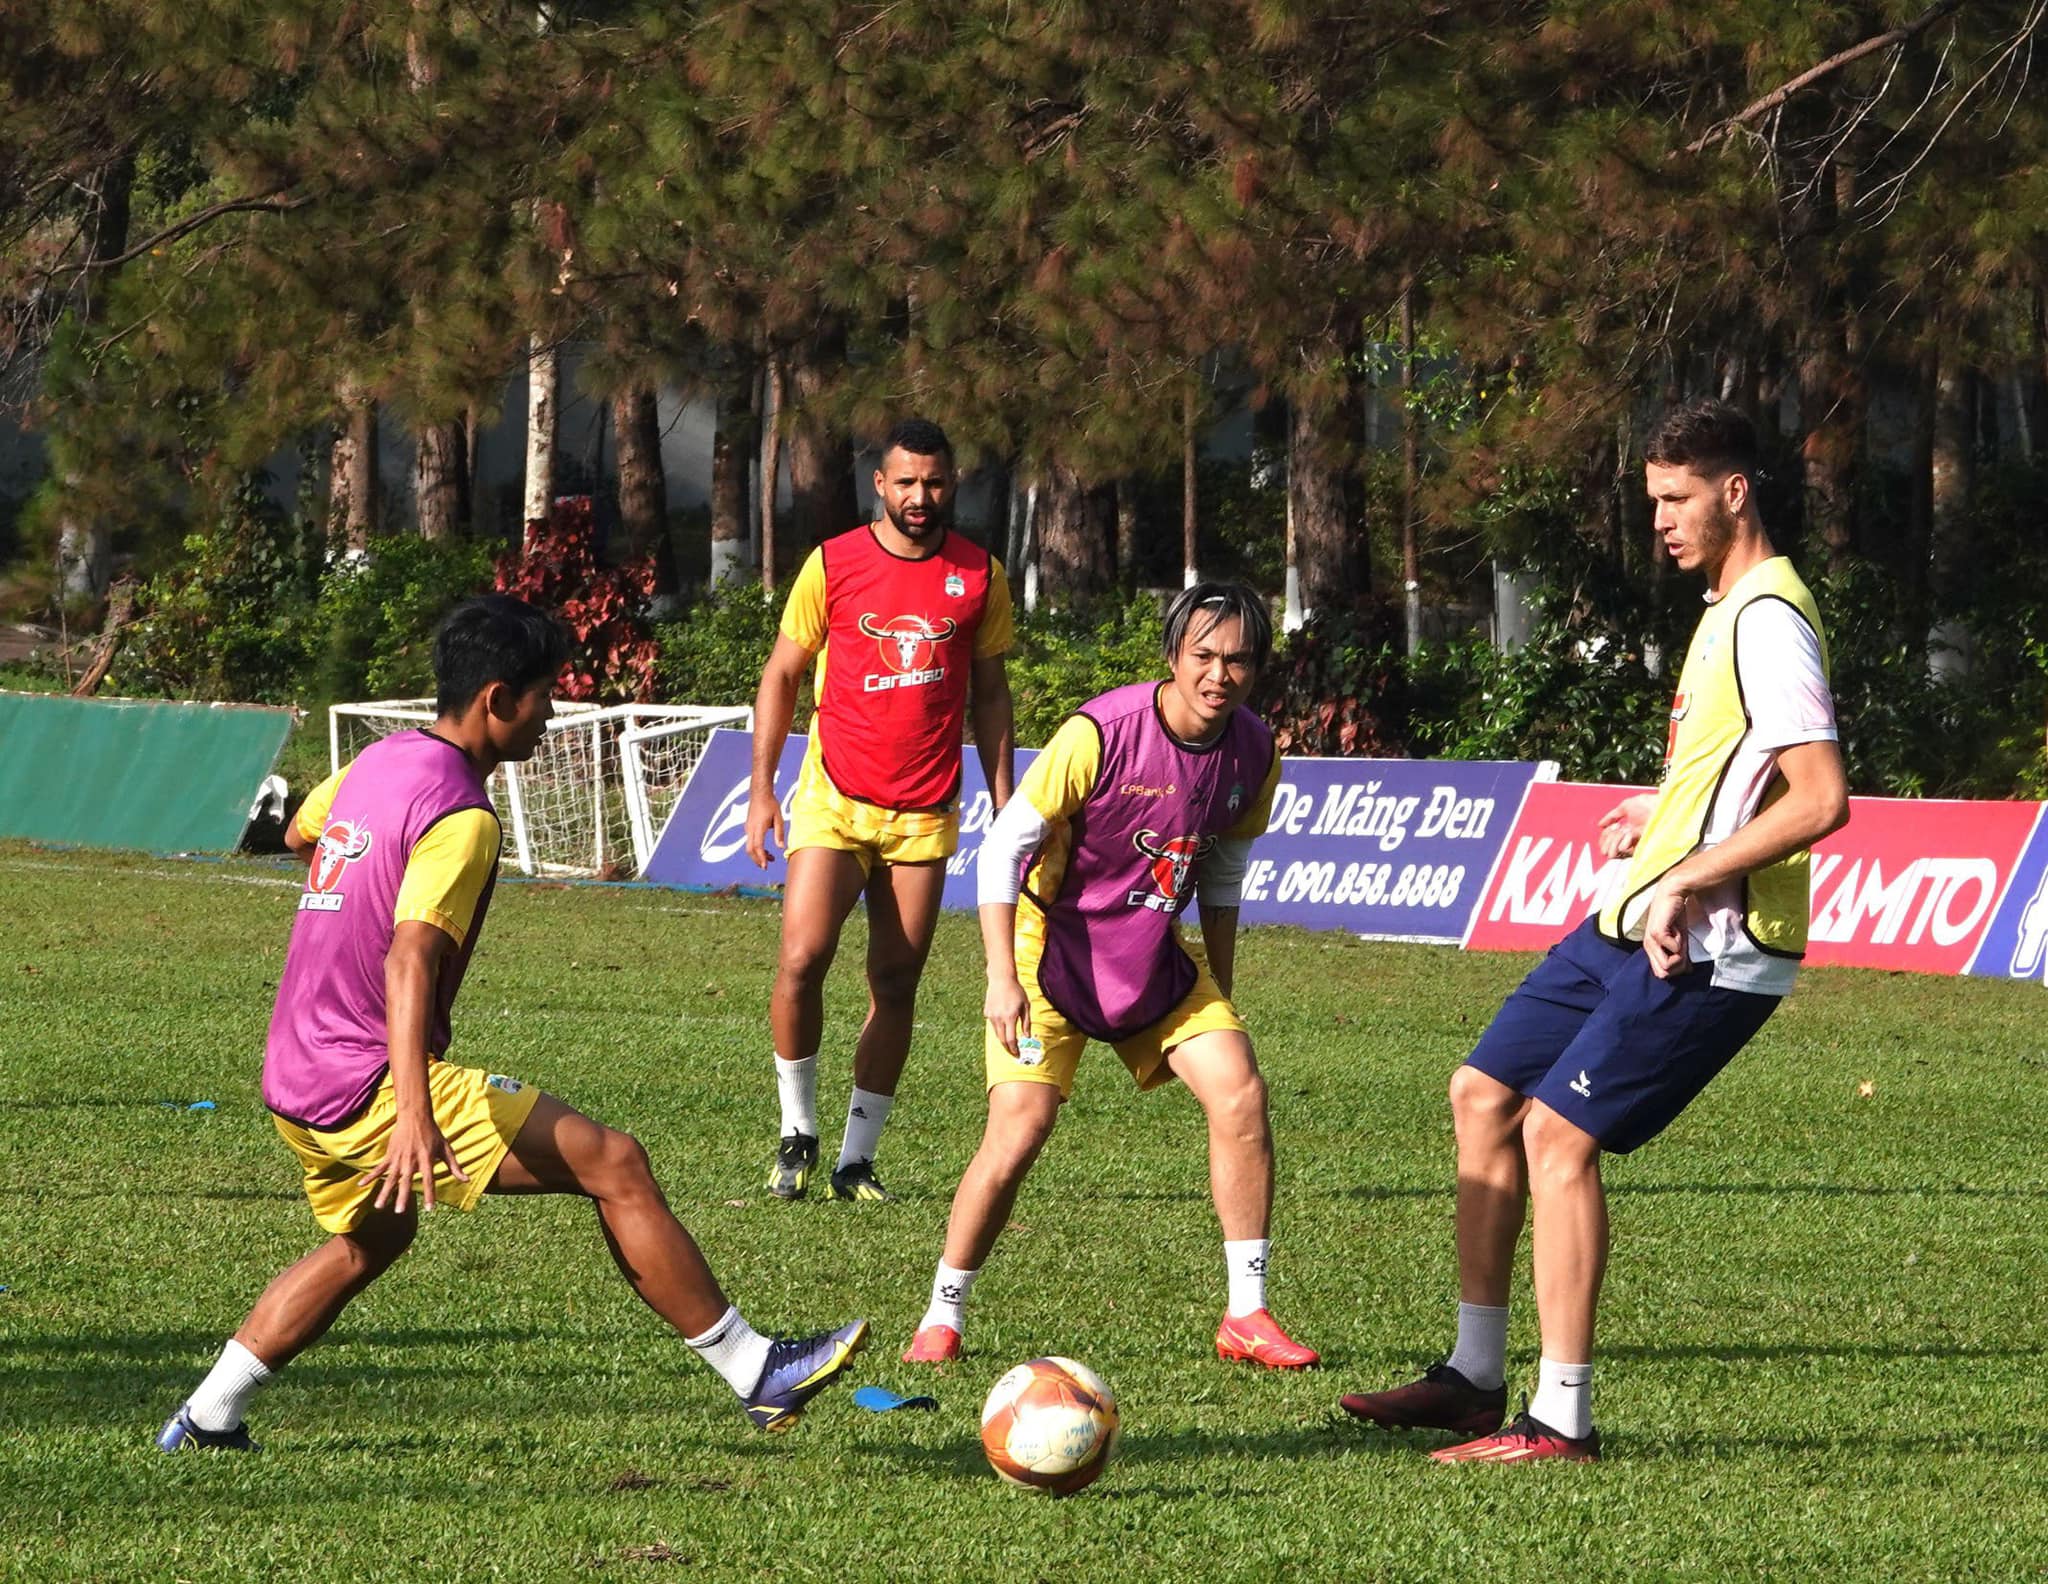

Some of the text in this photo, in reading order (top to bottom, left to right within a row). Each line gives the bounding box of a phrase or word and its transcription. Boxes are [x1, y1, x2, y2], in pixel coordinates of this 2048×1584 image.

[864, 667, 945, 693] Carabao
[1312, 780, 1420, 851] Măng
[1418, 786, 1495, 839] Đen
[1127, 890, 1178, 912] Cara
[1278, 862, 1465, 908] 090.858.8888
